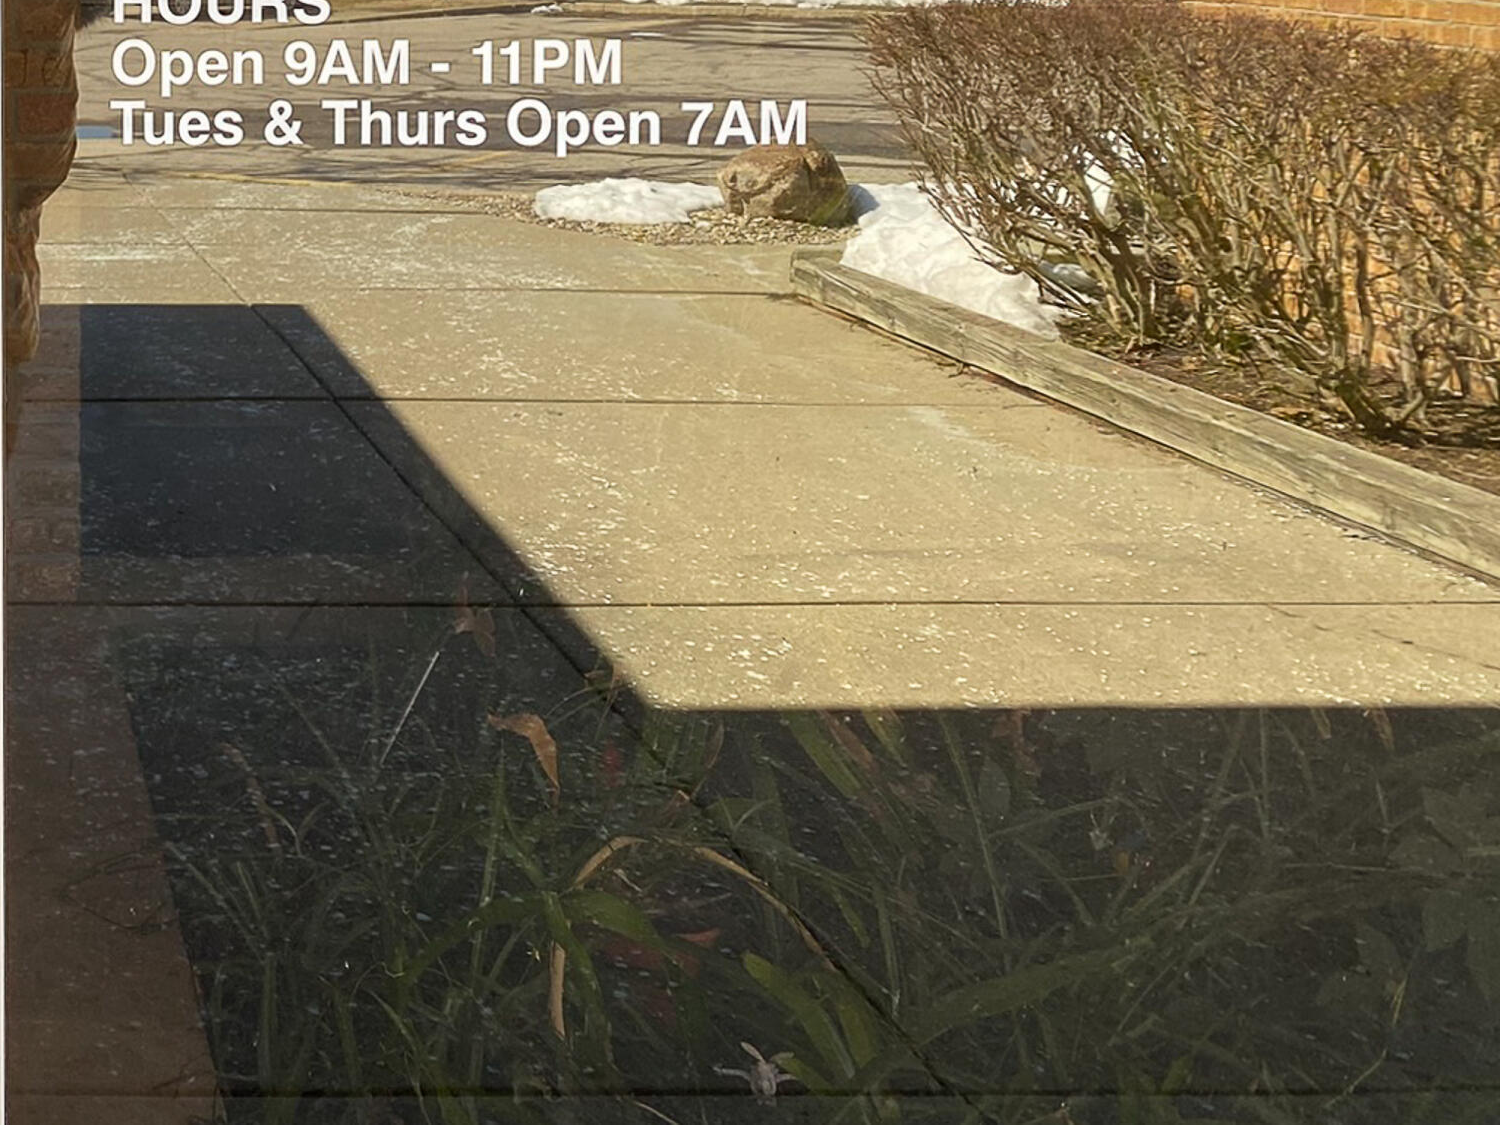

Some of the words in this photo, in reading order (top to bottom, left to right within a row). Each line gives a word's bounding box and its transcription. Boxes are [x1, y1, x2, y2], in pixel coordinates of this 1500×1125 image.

[111, 38, 263, 97] Open
[284, 39, 410, 85] 9AM
[431, 62, 450, 73] -
[472, 39, 623, 85] 11PM
[110, 100, 244, 146] Tues
[264, 100, 304, 146] &
[321, 99, 487, 146] Thurs
[506, 99, 661, 157] Open
[681, 99, 808, 146] 7AM
